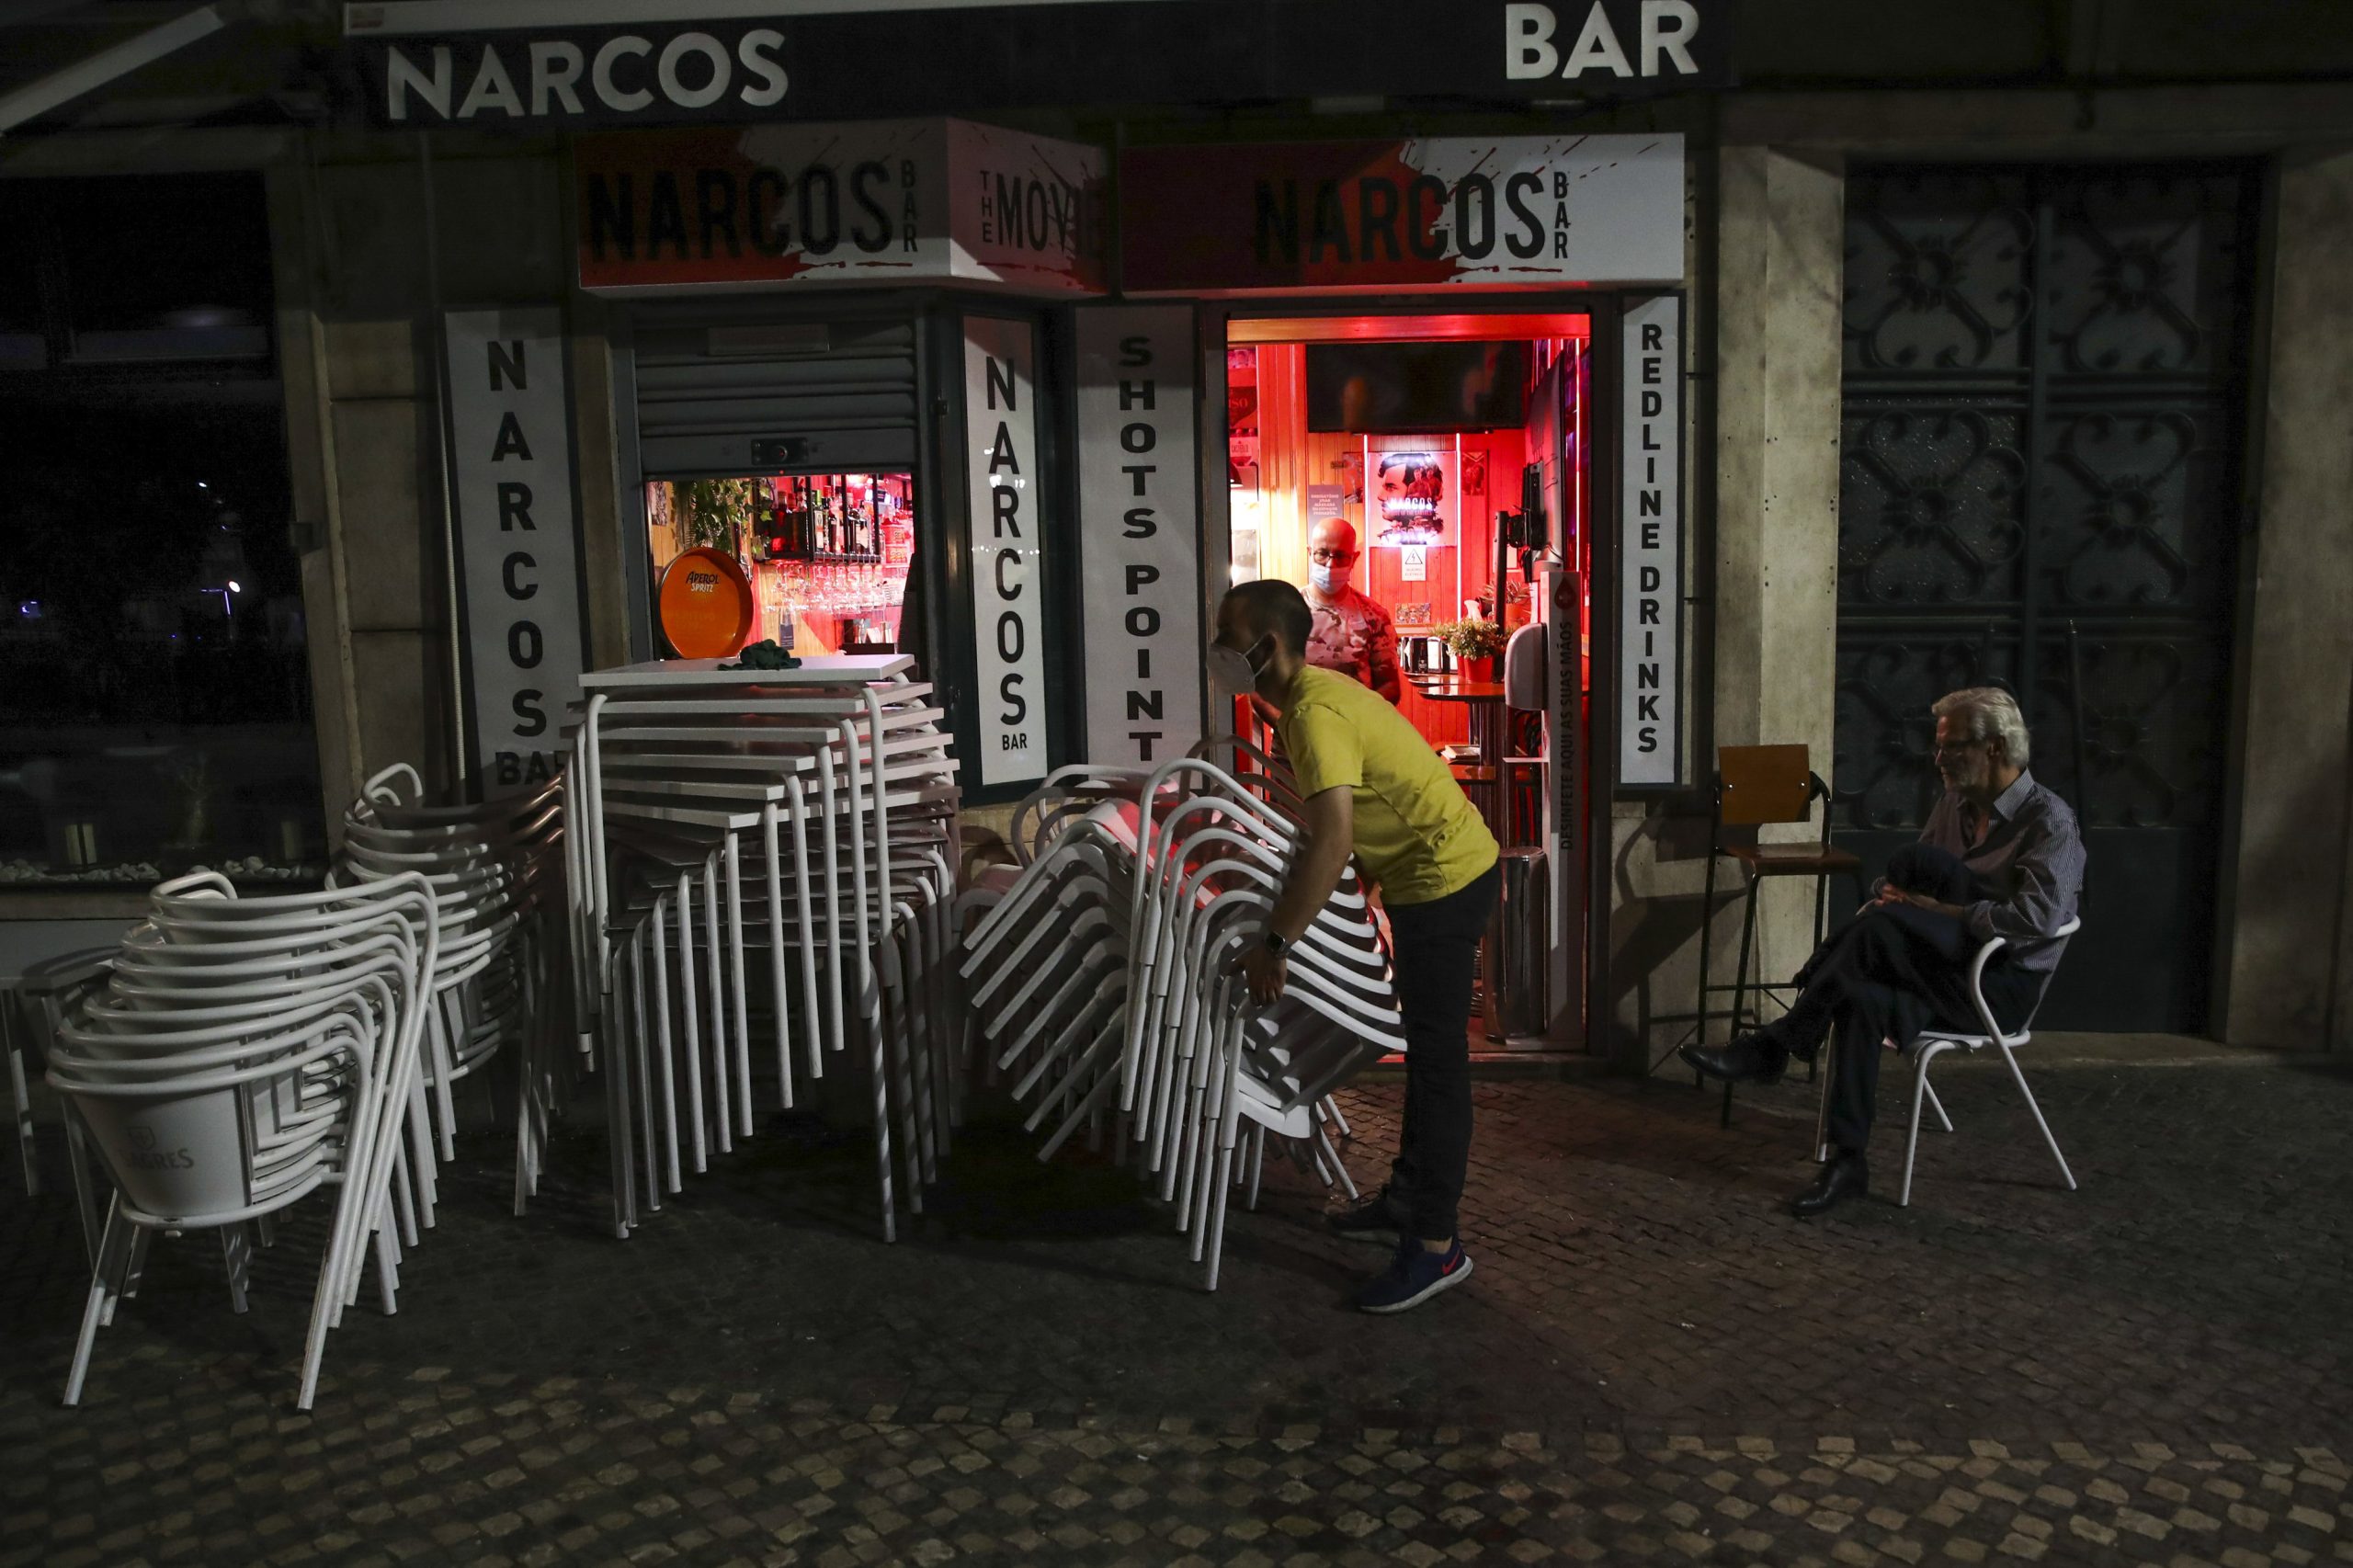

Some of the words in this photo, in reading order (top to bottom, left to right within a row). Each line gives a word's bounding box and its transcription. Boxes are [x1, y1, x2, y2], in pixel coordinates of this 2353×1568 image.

[387, 28, 790, 121] NARCOS
[1505, 0, 1699, 80] BAR
[586, 160, 892, 262] NARCOS
[901, 160, 918, 253] BAR
[980, 170, 993, 243] THE
[1255, 172, 1546, 263] NARCOS
[1553, 171, 1568, 259] BAR
[1118, 336, 1157, 539] SHOTS
[1639, 323, 1663, 550] REDLINE
[486, 339, 547, 737] NARCOS
[686, 571, 720, 585] APEROL
[986, 356, 1028, 725] NARCOS
[690, 583, 713, 593] SPRITZ
[1124, 564, 1164, 762] POINT
[1557, 621, 1573, 665] MÃOS
[1561, 670, 1573, 706] SUAS
[1637, 566, 1661, 754] DRINKS
[1002, 733, 1028, 751] BAR
[1561, 712, 1573, 729] AS
[1561, 775, 1573, 849] DESINFETE
